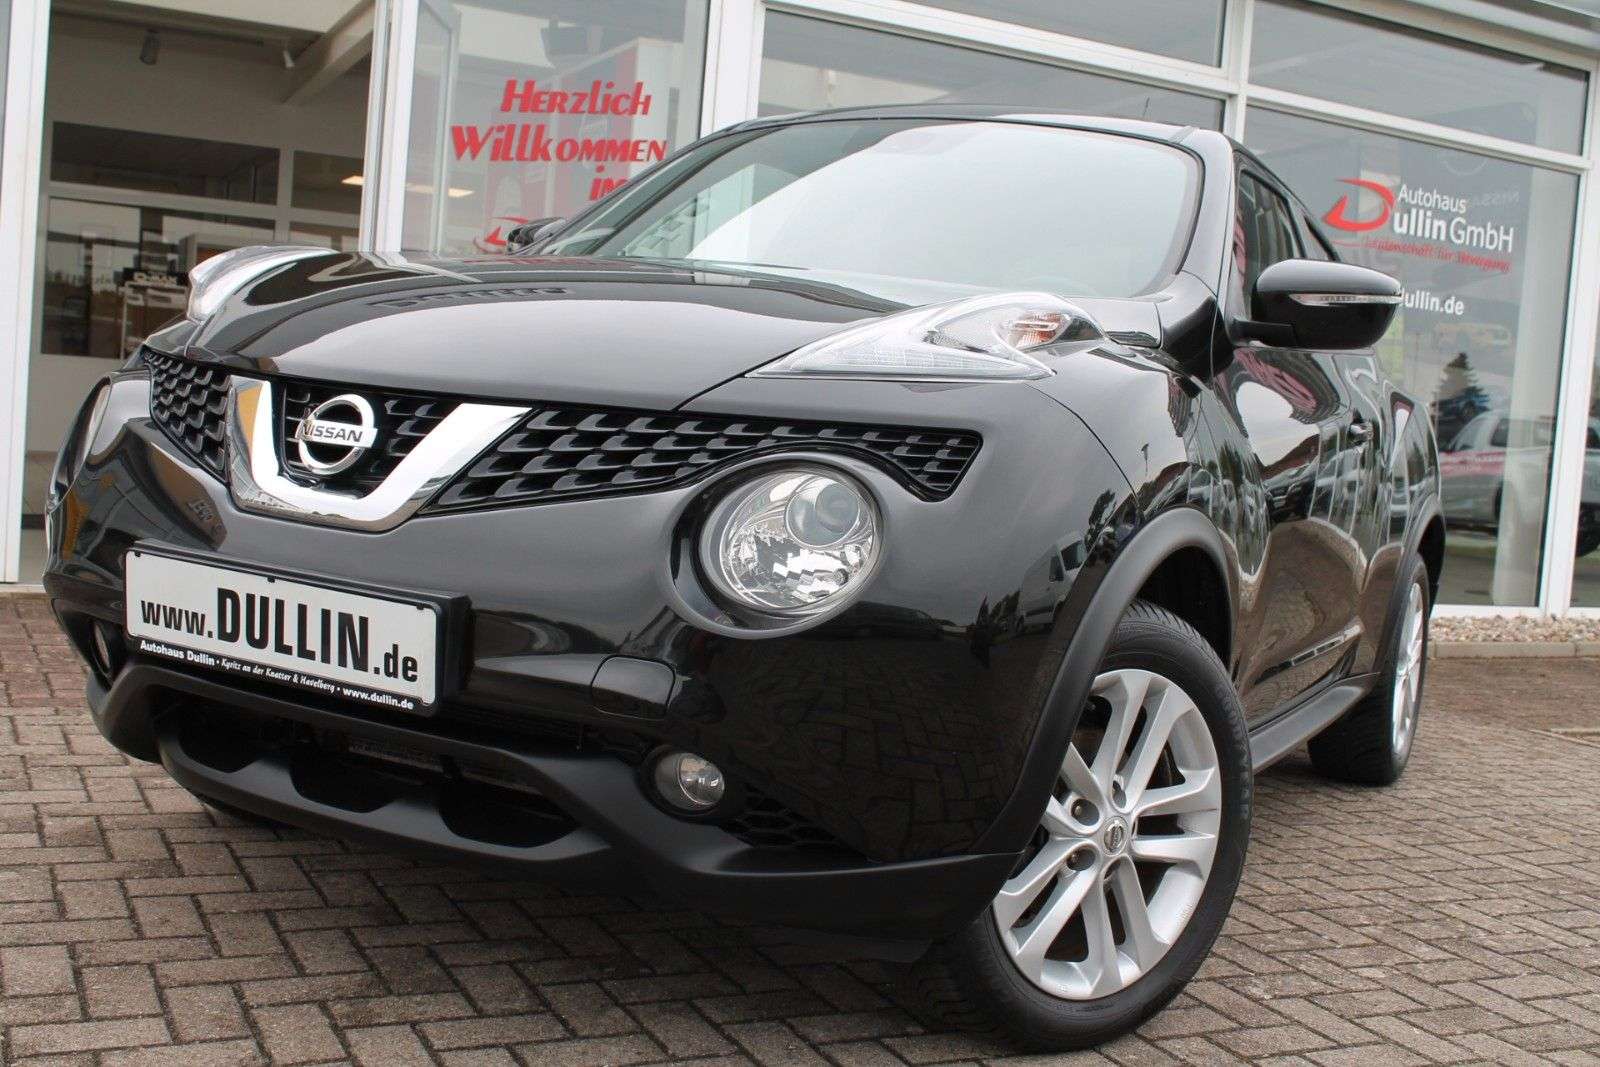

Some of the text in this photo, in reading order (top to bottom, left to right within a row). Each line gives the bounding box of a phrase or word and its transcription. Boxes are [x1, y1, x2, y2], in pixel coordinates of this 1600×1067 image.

[1398, 184, 1467, 214] Autohaus
[1450, 217, 1515, 253] GmbH
[302, 420, 363, 442] NISSAN
[140, 587, 418, 683] www.DULLIN.de
[140, 640, 185, 659] Autohaus
[187, 650, 215, 666] Dullin
[242, 665, 251, 673] an
[252, 665, 264, 675] der
[300, 675, 335, 694] Havelberg
[343, 687, 414, 710] www.dullin.de
